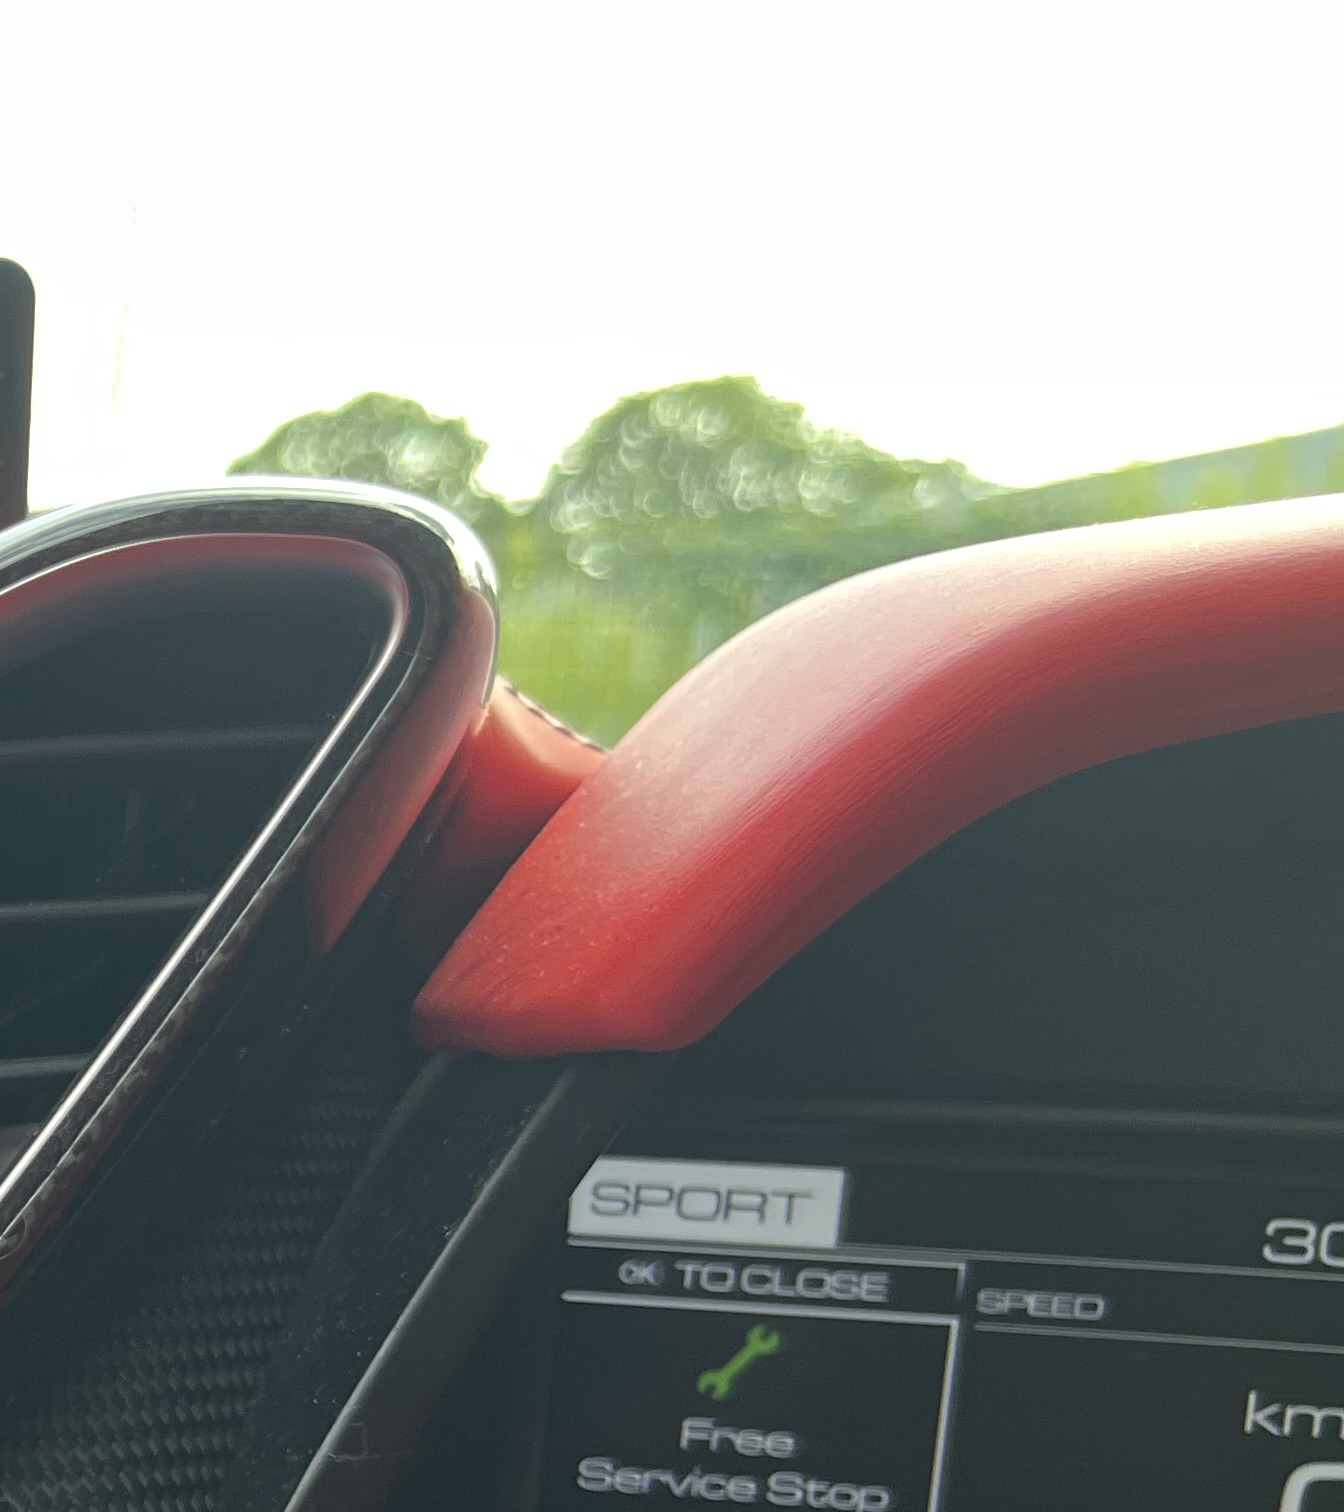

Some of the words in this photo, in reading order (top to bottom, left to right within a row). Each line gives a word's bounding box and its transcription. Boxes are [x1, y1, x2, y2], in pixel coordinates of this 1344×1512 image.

[590, 1180, 813, 1226] SPORT
[674, 1261, 735, 1294] TO
[739, 1263, 891, 1303] CLOSE
[976, 1287, 1106, 1321] SPEED
[679, 1417, 796, 1458] Free
[577, 1456, 758, 1502] Service
